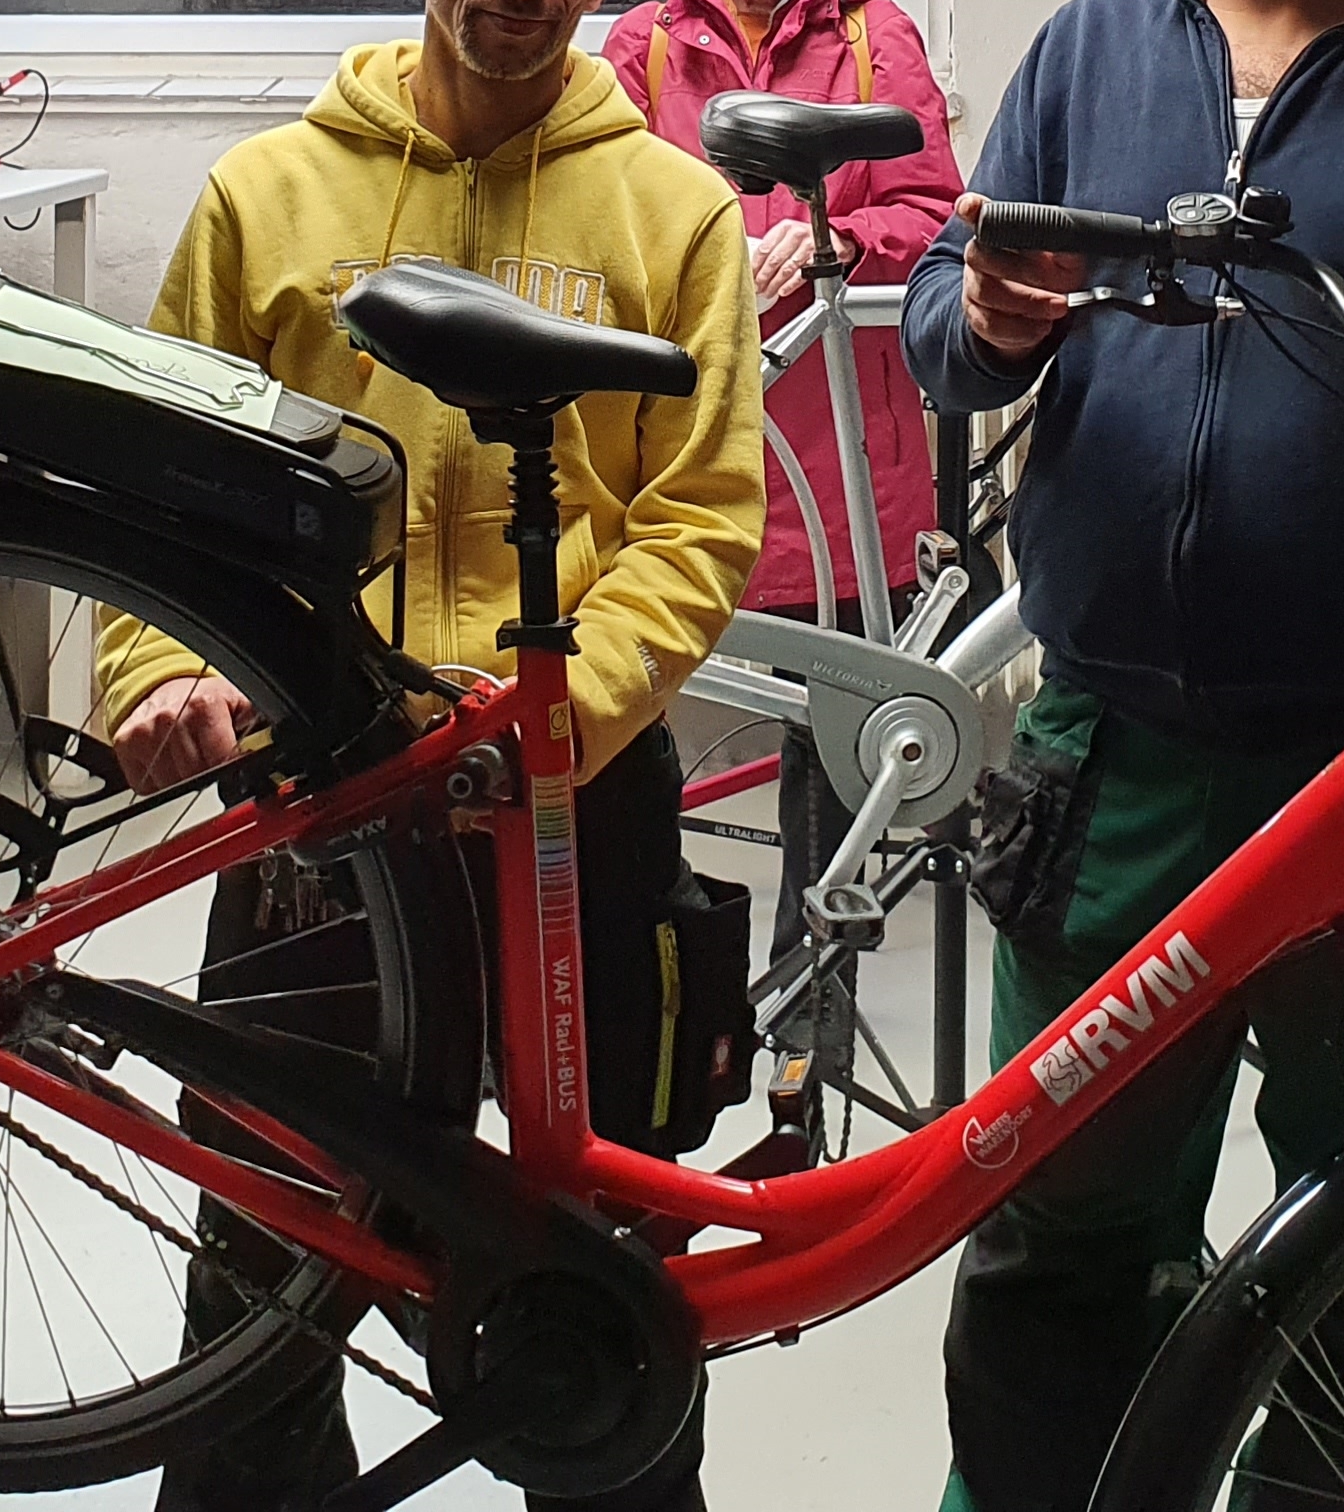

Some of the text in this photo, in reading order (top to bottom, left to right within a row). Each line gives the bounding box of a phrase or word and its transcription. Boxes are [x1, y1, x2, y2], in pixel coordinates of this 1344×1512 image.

[812, 661, 874, 689] VICTORIA
[714, 824, 777, 843] ULTRALIGHT
[551, 955, 573, 1006] WAF
[1069, 930, 1211, 1071] RVM
